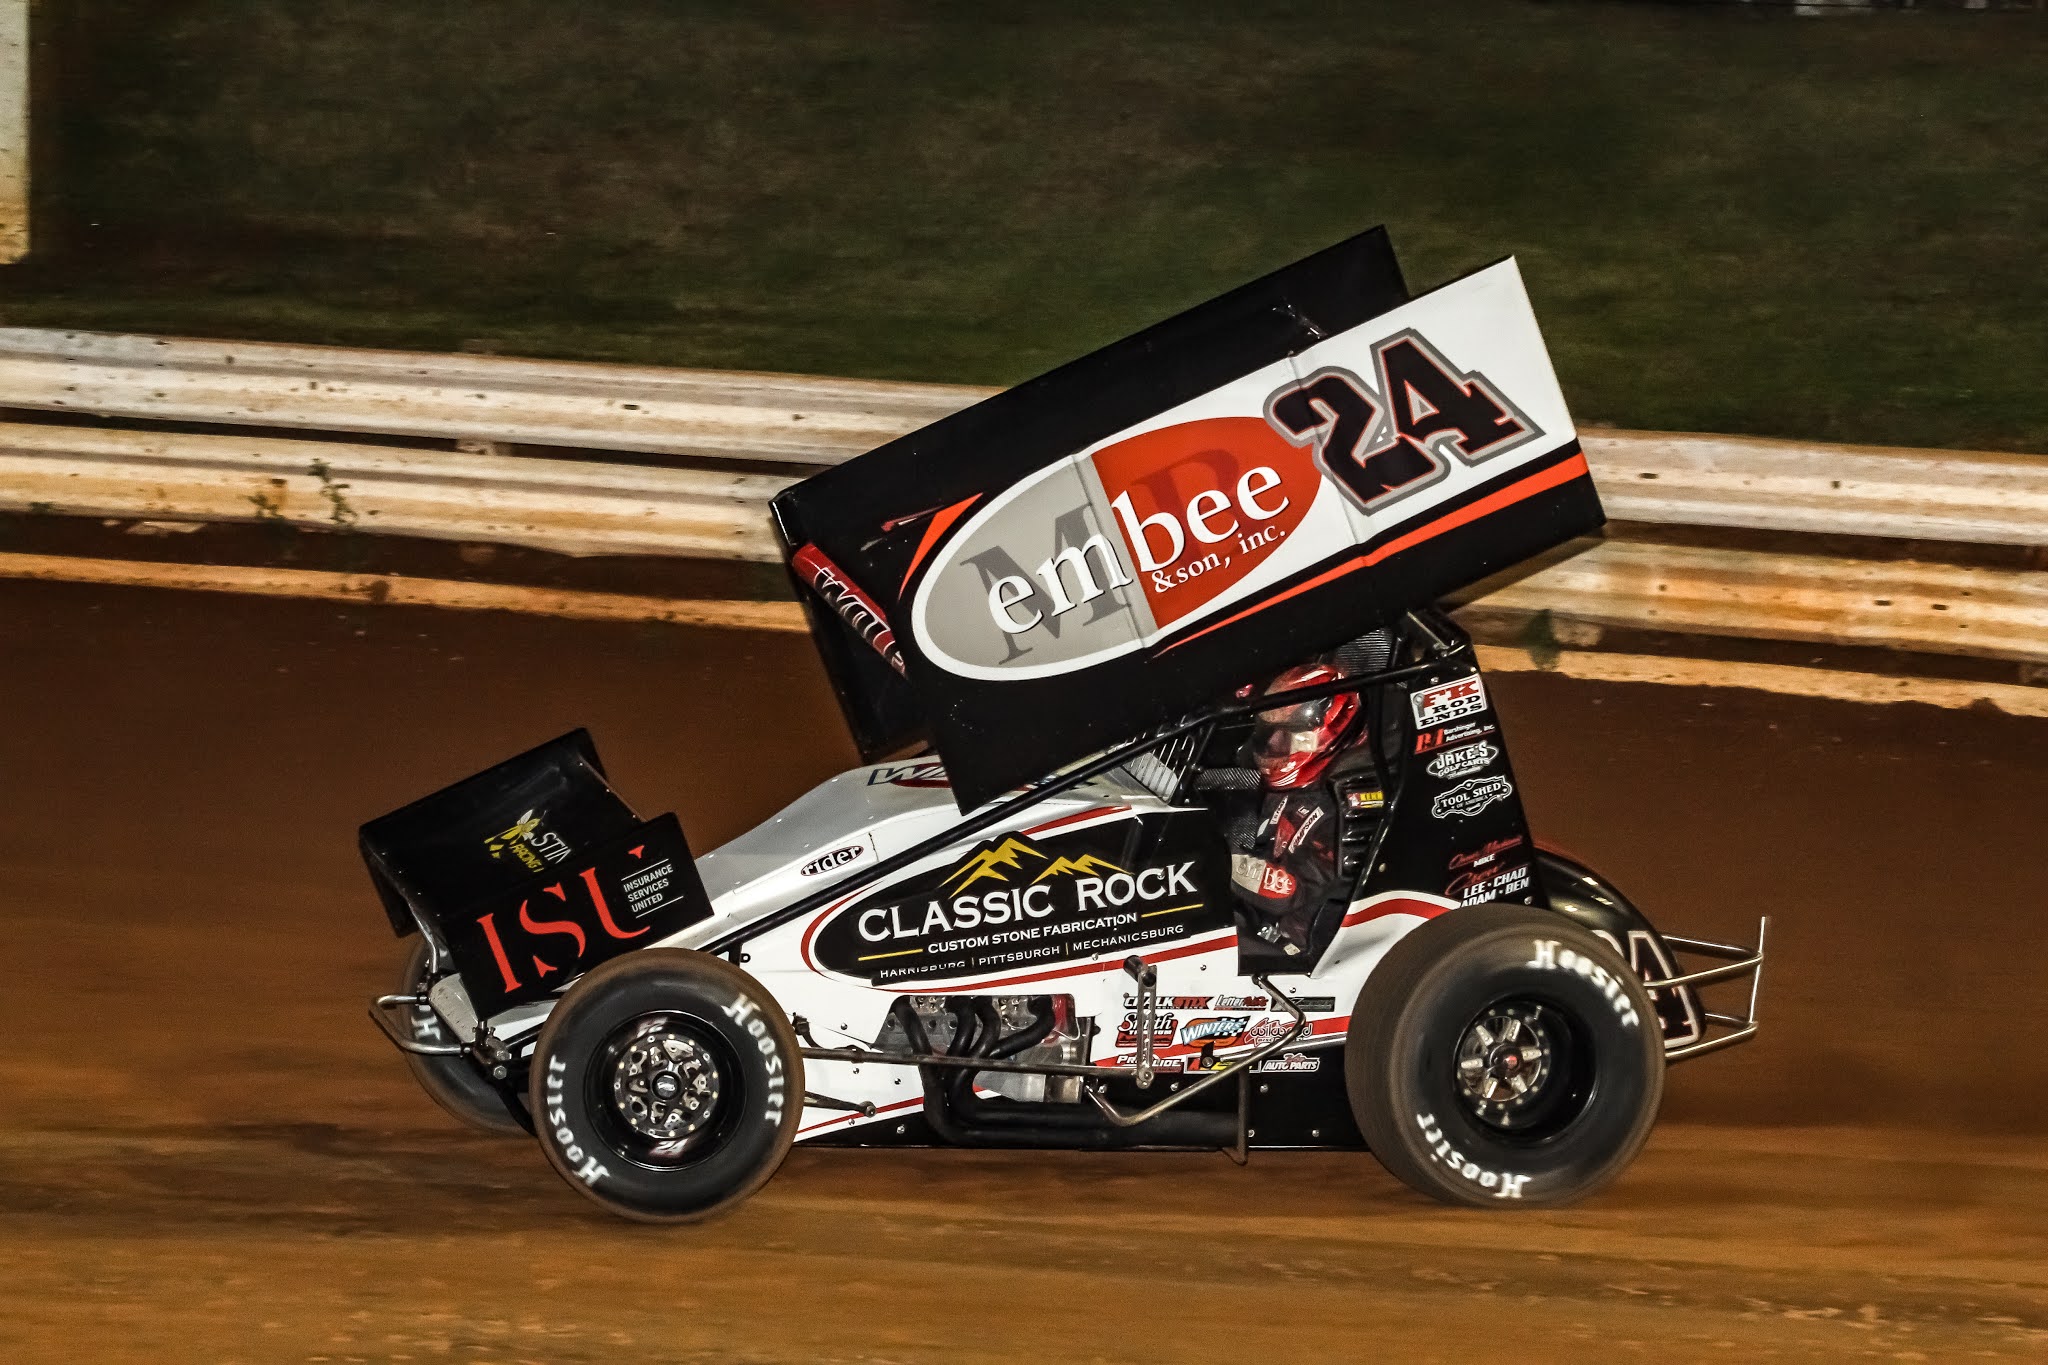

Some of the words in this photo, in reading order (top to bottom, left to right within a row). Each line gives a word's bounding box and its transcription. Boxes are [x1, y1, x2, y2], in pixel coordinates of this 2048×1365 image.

[1264, 329, 1545, 516] 24
[988, 466, 1291, 634] embee
[1238, 522, 1287, 556] inc.
[1423, 681, 1479, 708] FK
[1432, 695, 1481, 714] ROD
[1420, 703, 1482, 726] ENDS
[1436, 740, 1488, 769] JAKE'S
[1438, 762, 1461, 778] GOLF
[1462, 757, 1491, 768] CARTS
[1441, 793, 1471, 808] TOOL
[1472, 782, 1502, 798] SHED
[802, 846, 861, 876] rider
[1473, 853, 1496, 868] MIKE
[623, 864, 674, 893] INSURANCE
[627, 878, 670, 903] SERVICES
[1460, 888, 1497, 908] ADAM
[1504, 877, 1530, 895] BEN
[1463, 881, 1487, 899] LEE
[1493, 866, 1528, 888] CHAD
[631, 893, 664, 913] UNITED
[858, 884, 1055, 942] CLASSIC
[1074, 860, 1198, 912] ROCK
[928, 935, 990, 954] CUSTOM
[991, 927, 1041, 945] STONE
[1042, 912, 1138, 937] FABRICATION
[978, 945, 1060, 966] PITTSBURGH
[1072, 924, 1184, 951] MECHANICSBURG
[1527, 938, 1640, 1028] Hoosier
[1180, 1019, 1245, 1045] WINTERS
[723, 993, 784, 1128] Hoosier
[1264, 1061, 1289, 1071] AUTO
[1289, 1061, 1318, 1071] PARTS
[546, 1054, 611, 1187] Hoosier
[1416, 1111, 1532, 1200] Hoosier
